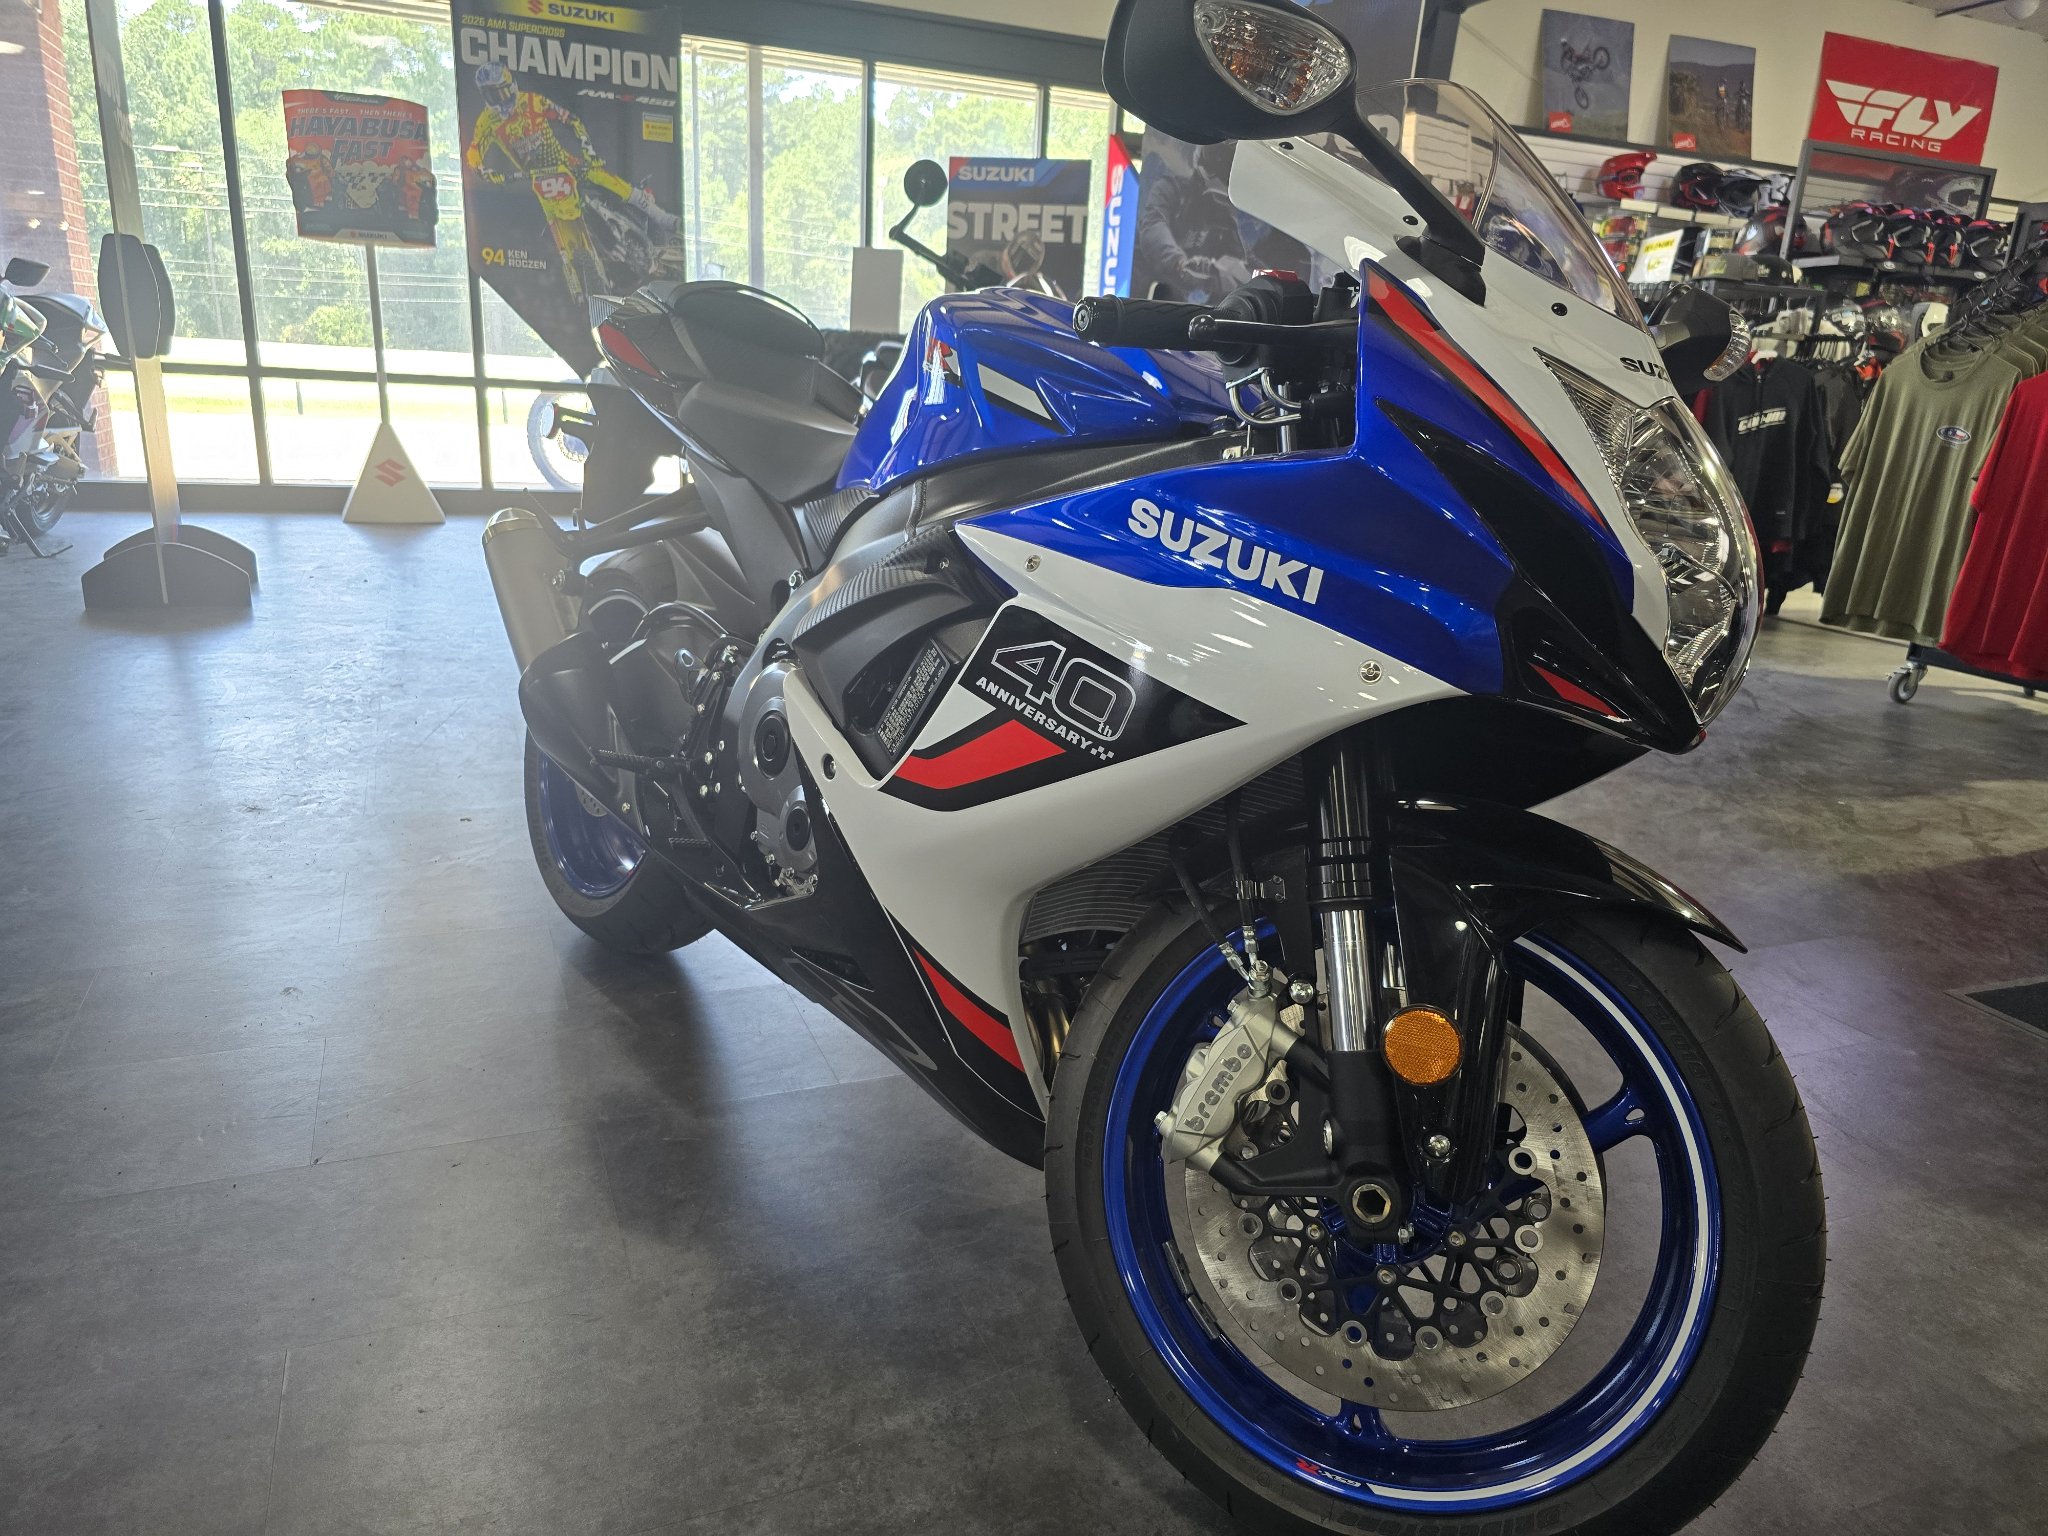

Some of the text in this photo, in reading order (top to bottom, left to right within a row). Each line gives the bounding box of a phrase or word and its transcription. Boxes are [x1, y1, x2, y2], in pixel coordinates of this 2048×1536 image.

[548, 3, 615, 24] SUZUKI
[486, 18, 507, 30] AMA
[508, 21, 566, 38] SUPERCROSS
[460, 27, 678, 93] CHAMPION
[360, 108, 380, 116] THEN
[1825, 79, 1982, 140] FLY
[289, 115, 428, 140] HAYABUSA
[1851, 128, 1942, 153] RACING
[331, 138, 395, 169] FAST
[542, 176, 572, 198] 94
[958, 165, 1035, 183] SUZUKI
[947, 201, 1089, 244] STREET
[1103, 164, 1125, 296] SUZU
[482, 247, 528, 267] 94 KEN
[508, 259, 547, 270] ROCZEN
[1128, 498, 1324, 605] SUZUKI
[990, 640, 1137, 742] 40
[1098, 721, 1113, 738] th
[975, 676, 1093, 750] ANNIVERSARY
[1183, 1043, 1252, 1132] brembo
